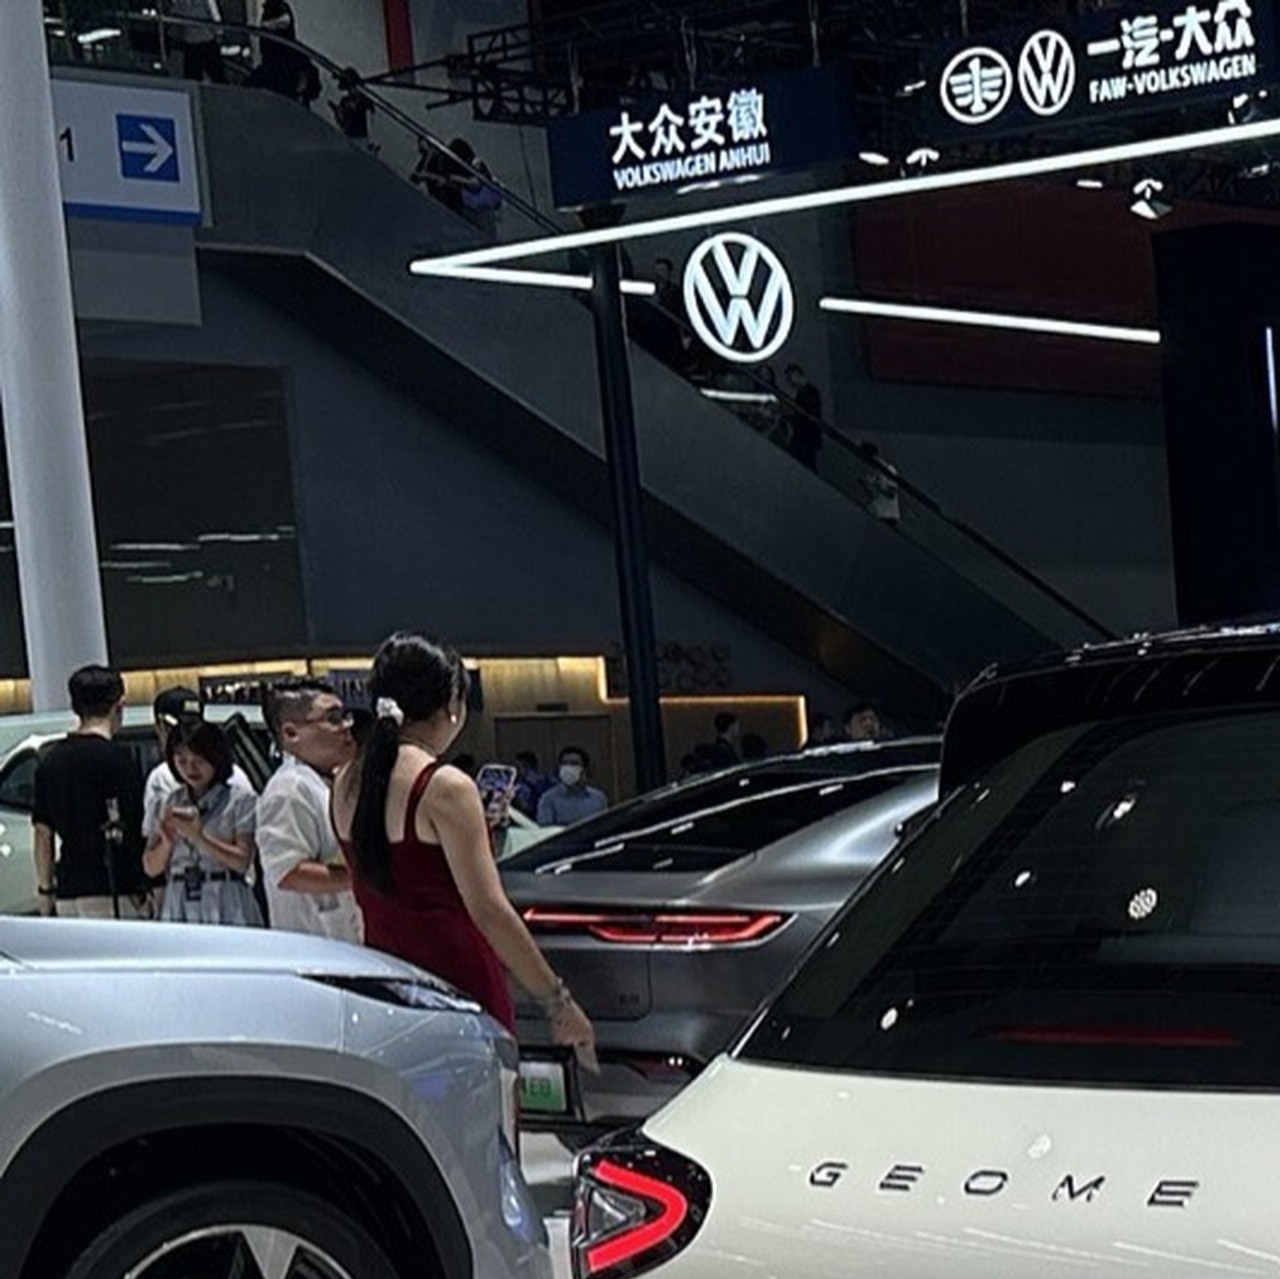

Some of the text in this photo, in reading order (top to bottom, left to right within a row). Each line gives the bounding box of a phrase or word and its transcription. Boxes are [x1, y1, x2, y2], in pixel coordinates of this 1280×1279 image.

[609, 87, 768, 165] 大众安徽
[613, 142, 771, 191] VOLKSWAGEN ANHUI
[809, 1160, 1200, 1208] GEOME
